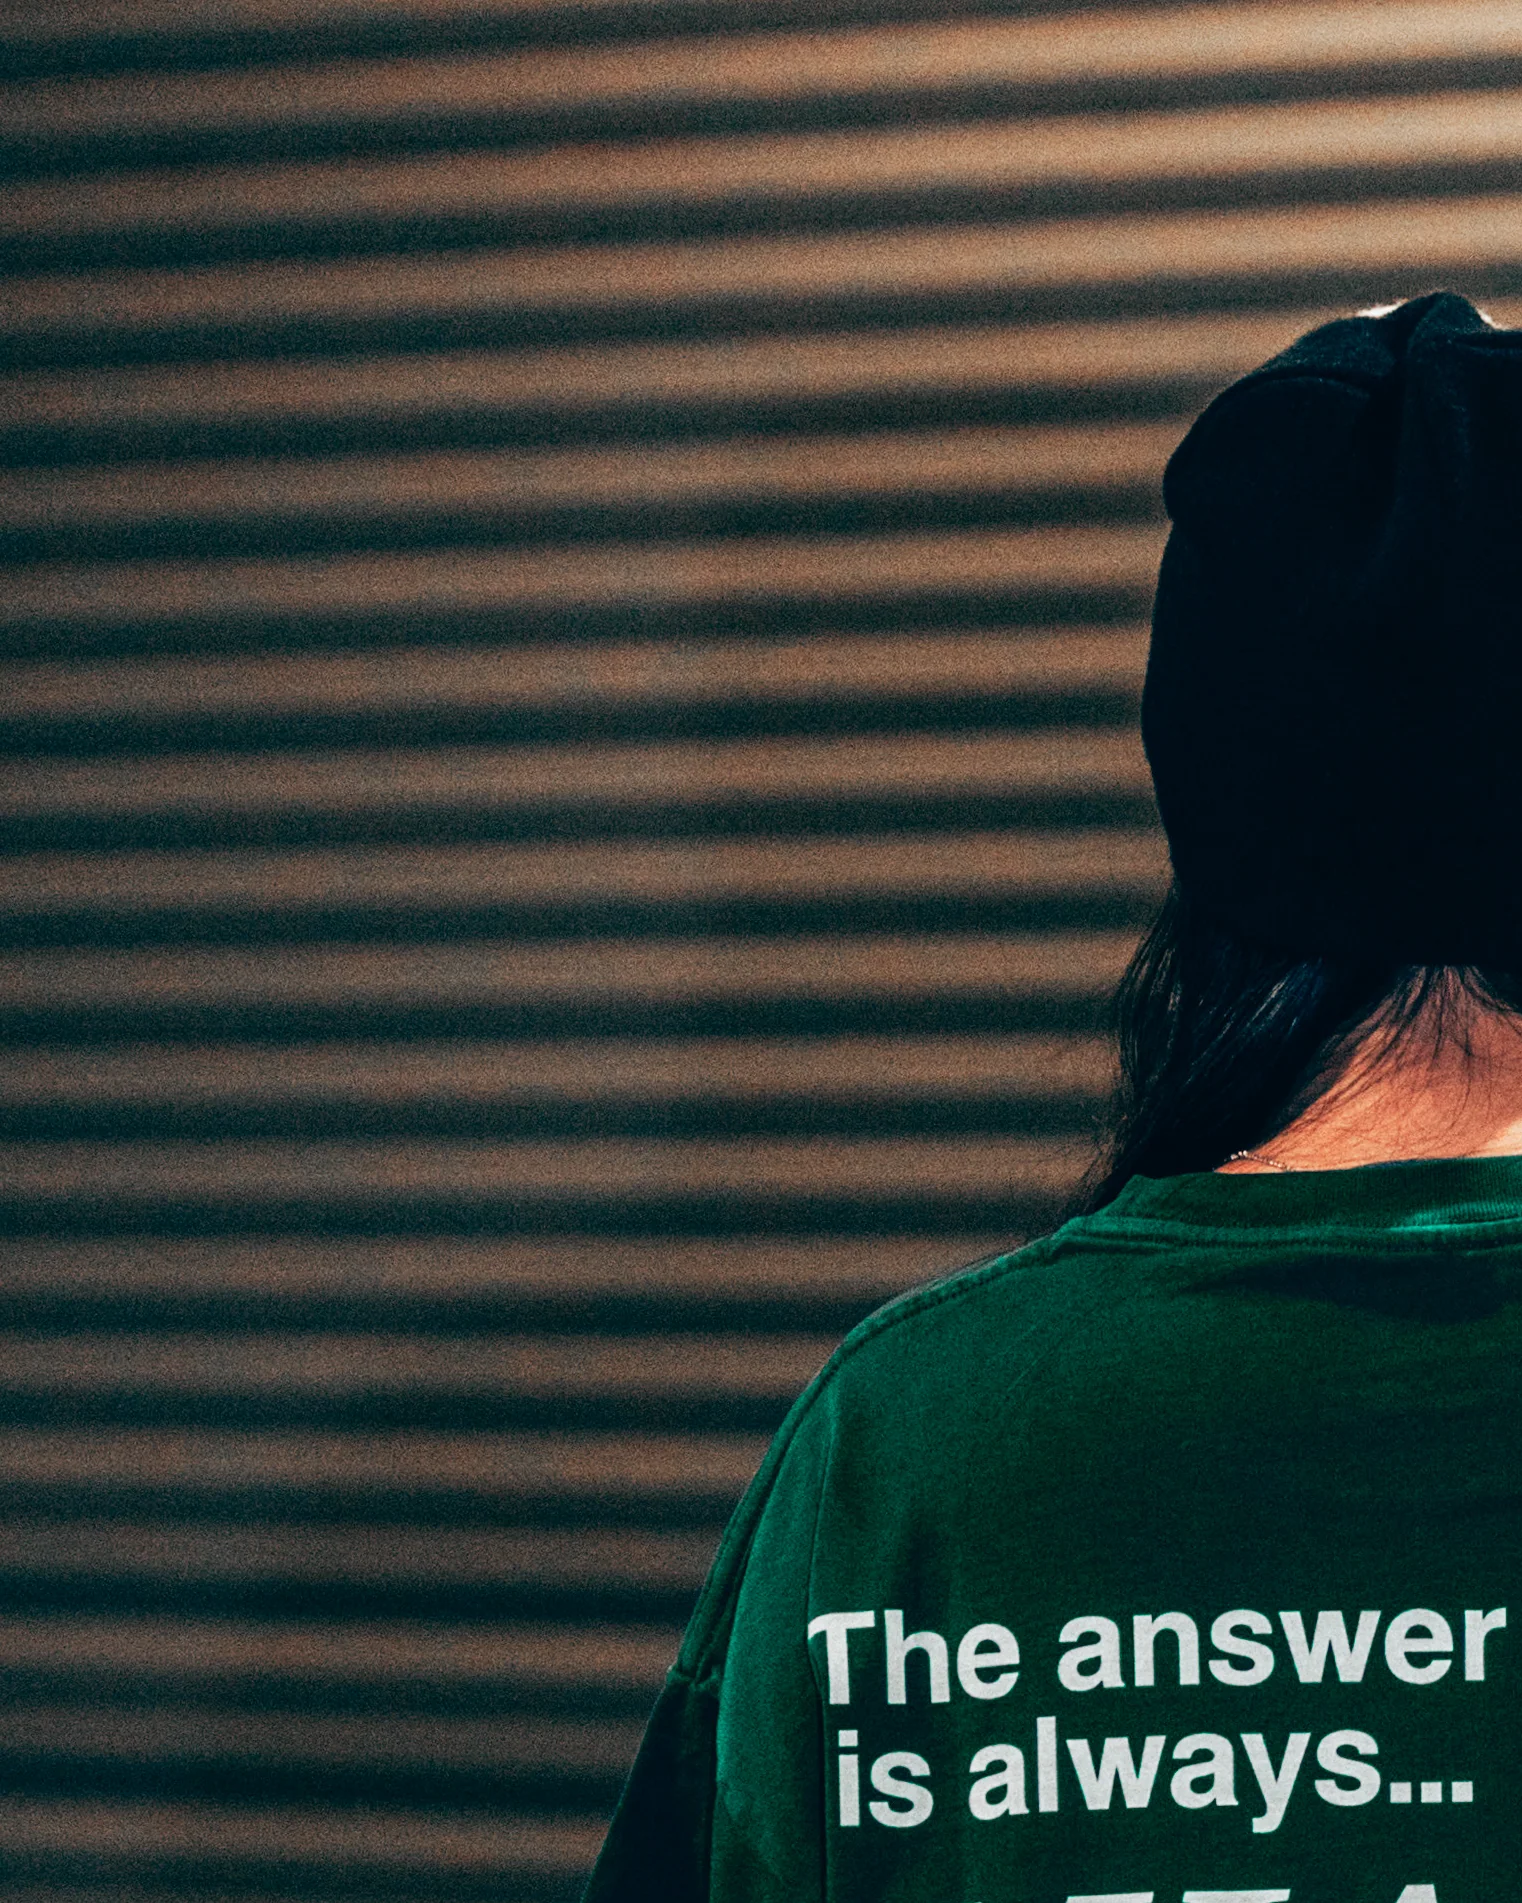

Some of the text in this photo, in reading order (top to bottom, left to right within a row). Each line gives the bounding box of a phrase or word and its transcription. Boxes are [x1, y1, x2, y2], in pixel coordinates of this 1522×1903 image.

[807, 1607, 1507, 1705] The answer
[838, 1715, 1474, 1834] is always...
